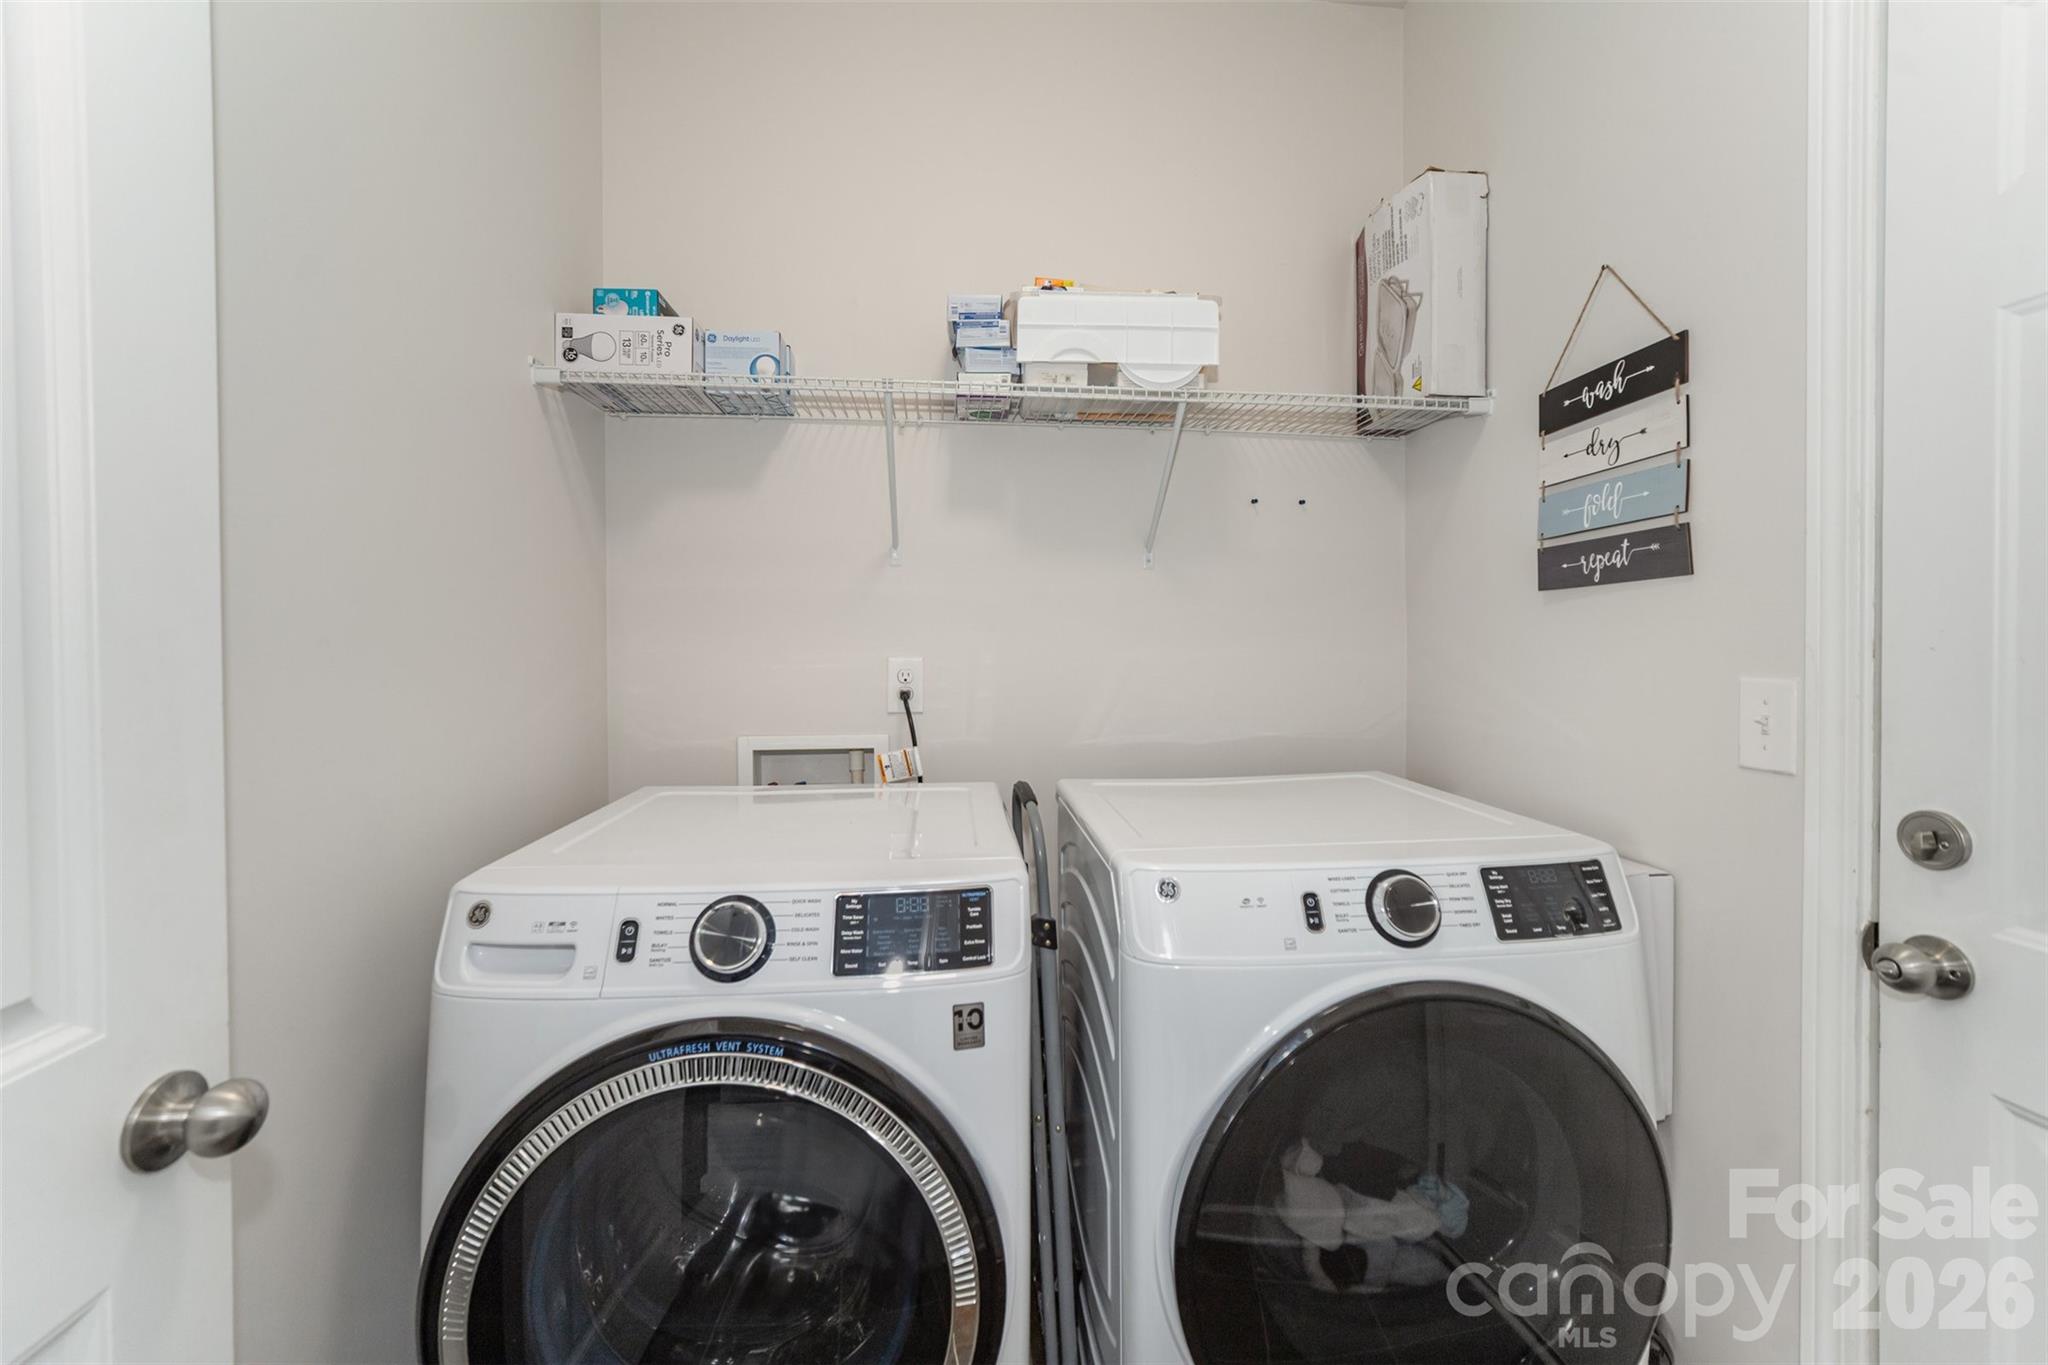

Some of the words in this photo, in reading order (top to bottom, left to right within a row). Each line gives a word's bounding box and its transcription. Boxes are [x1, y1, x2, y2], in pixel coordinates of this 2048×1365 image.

[622, 337, 631, 348] 13
[656, 329, 664, 356] Series
[664, 341, 672, 357] Pro
[723, 335, 750, 343] Daylight
[568, 349, 577, 359] 16
[1581, 359, 1628, 408] wash
[1585, 426, 1623, 466] dry
[1583, 481, 1624, 528] fold
[1580, 538, 1630, 582] repeat
[954, 1008, 984, 1031] 10
[648, 1041, 711, 1062] ULTRAFRESH
[715, 1041, 742, 1053] VENT
[746, 1042, 784, 1057] SYSTEM
